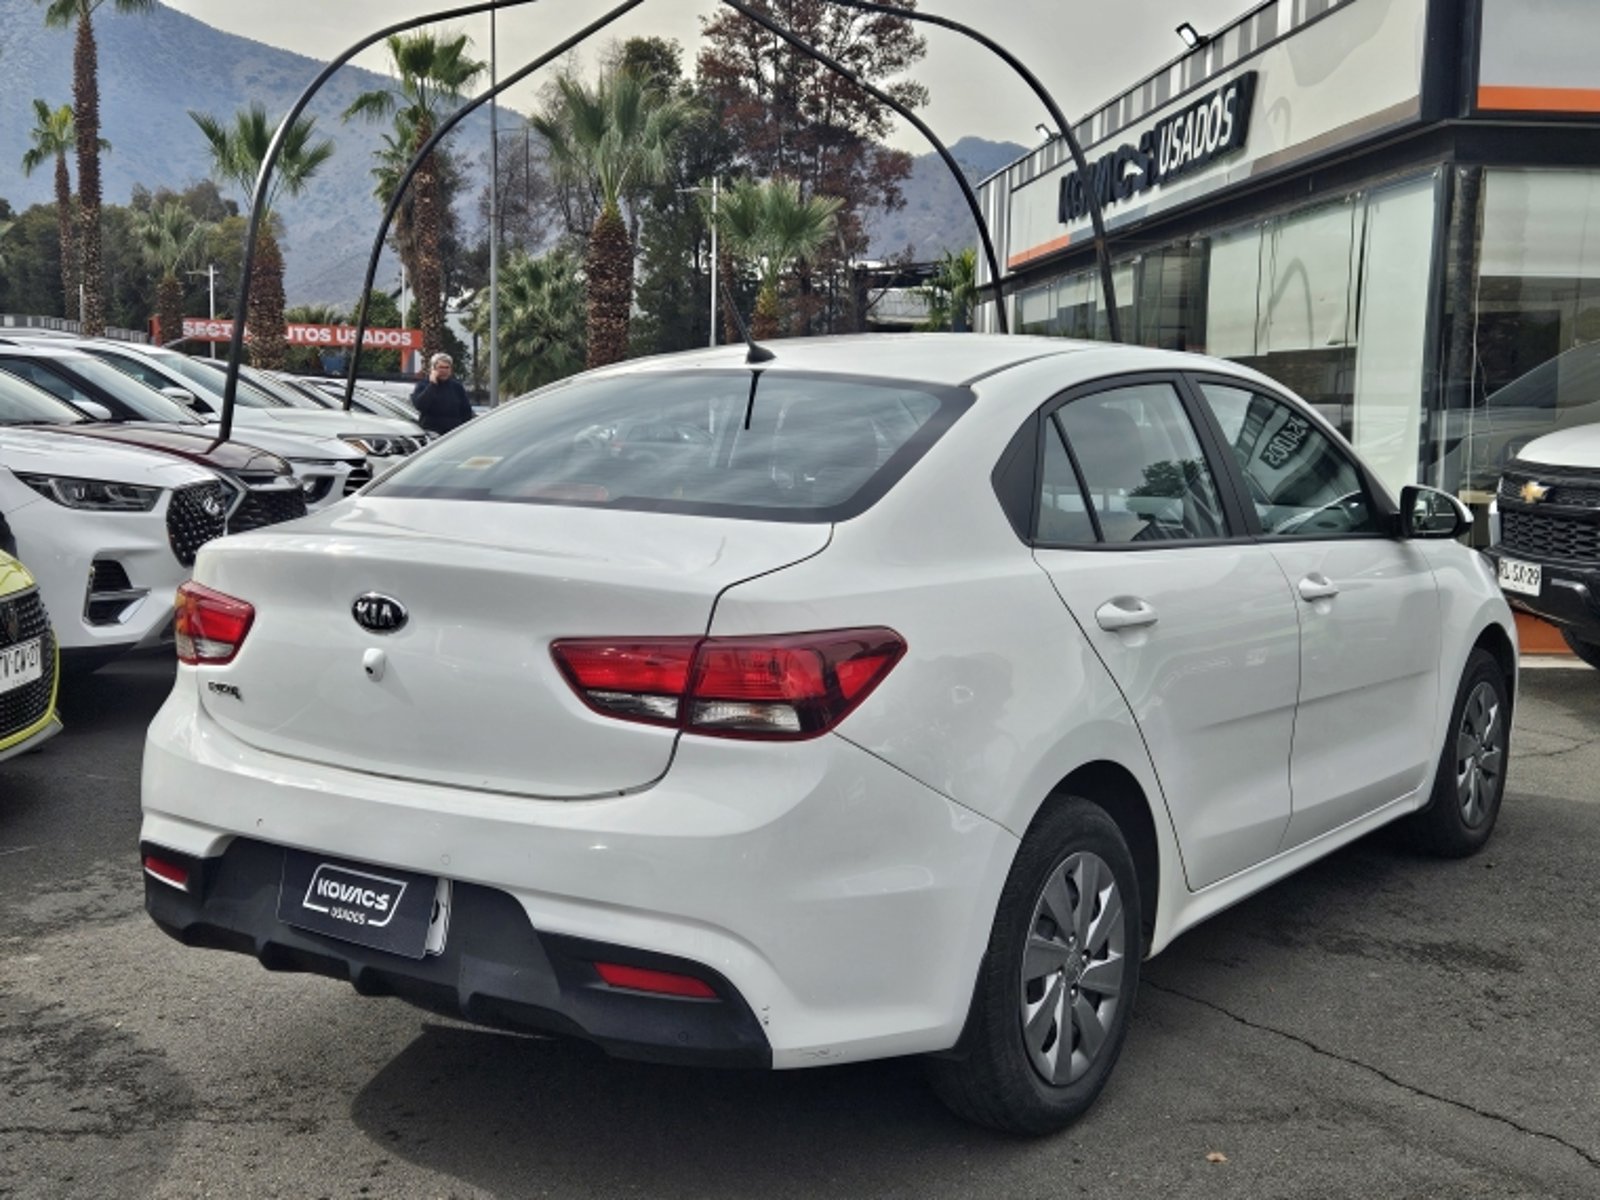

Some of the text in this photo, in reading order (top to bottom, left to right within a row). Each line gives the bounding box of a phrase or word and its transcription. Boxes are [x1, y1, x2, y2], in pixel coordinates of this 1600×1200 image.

[1159, 87, 1236, 175] USADOS
[183, 321, 412, 346] SECT UTOS USADOS
[357, 600, 396, 627] KIA
[317, 877, 391, 911] KOVACS
